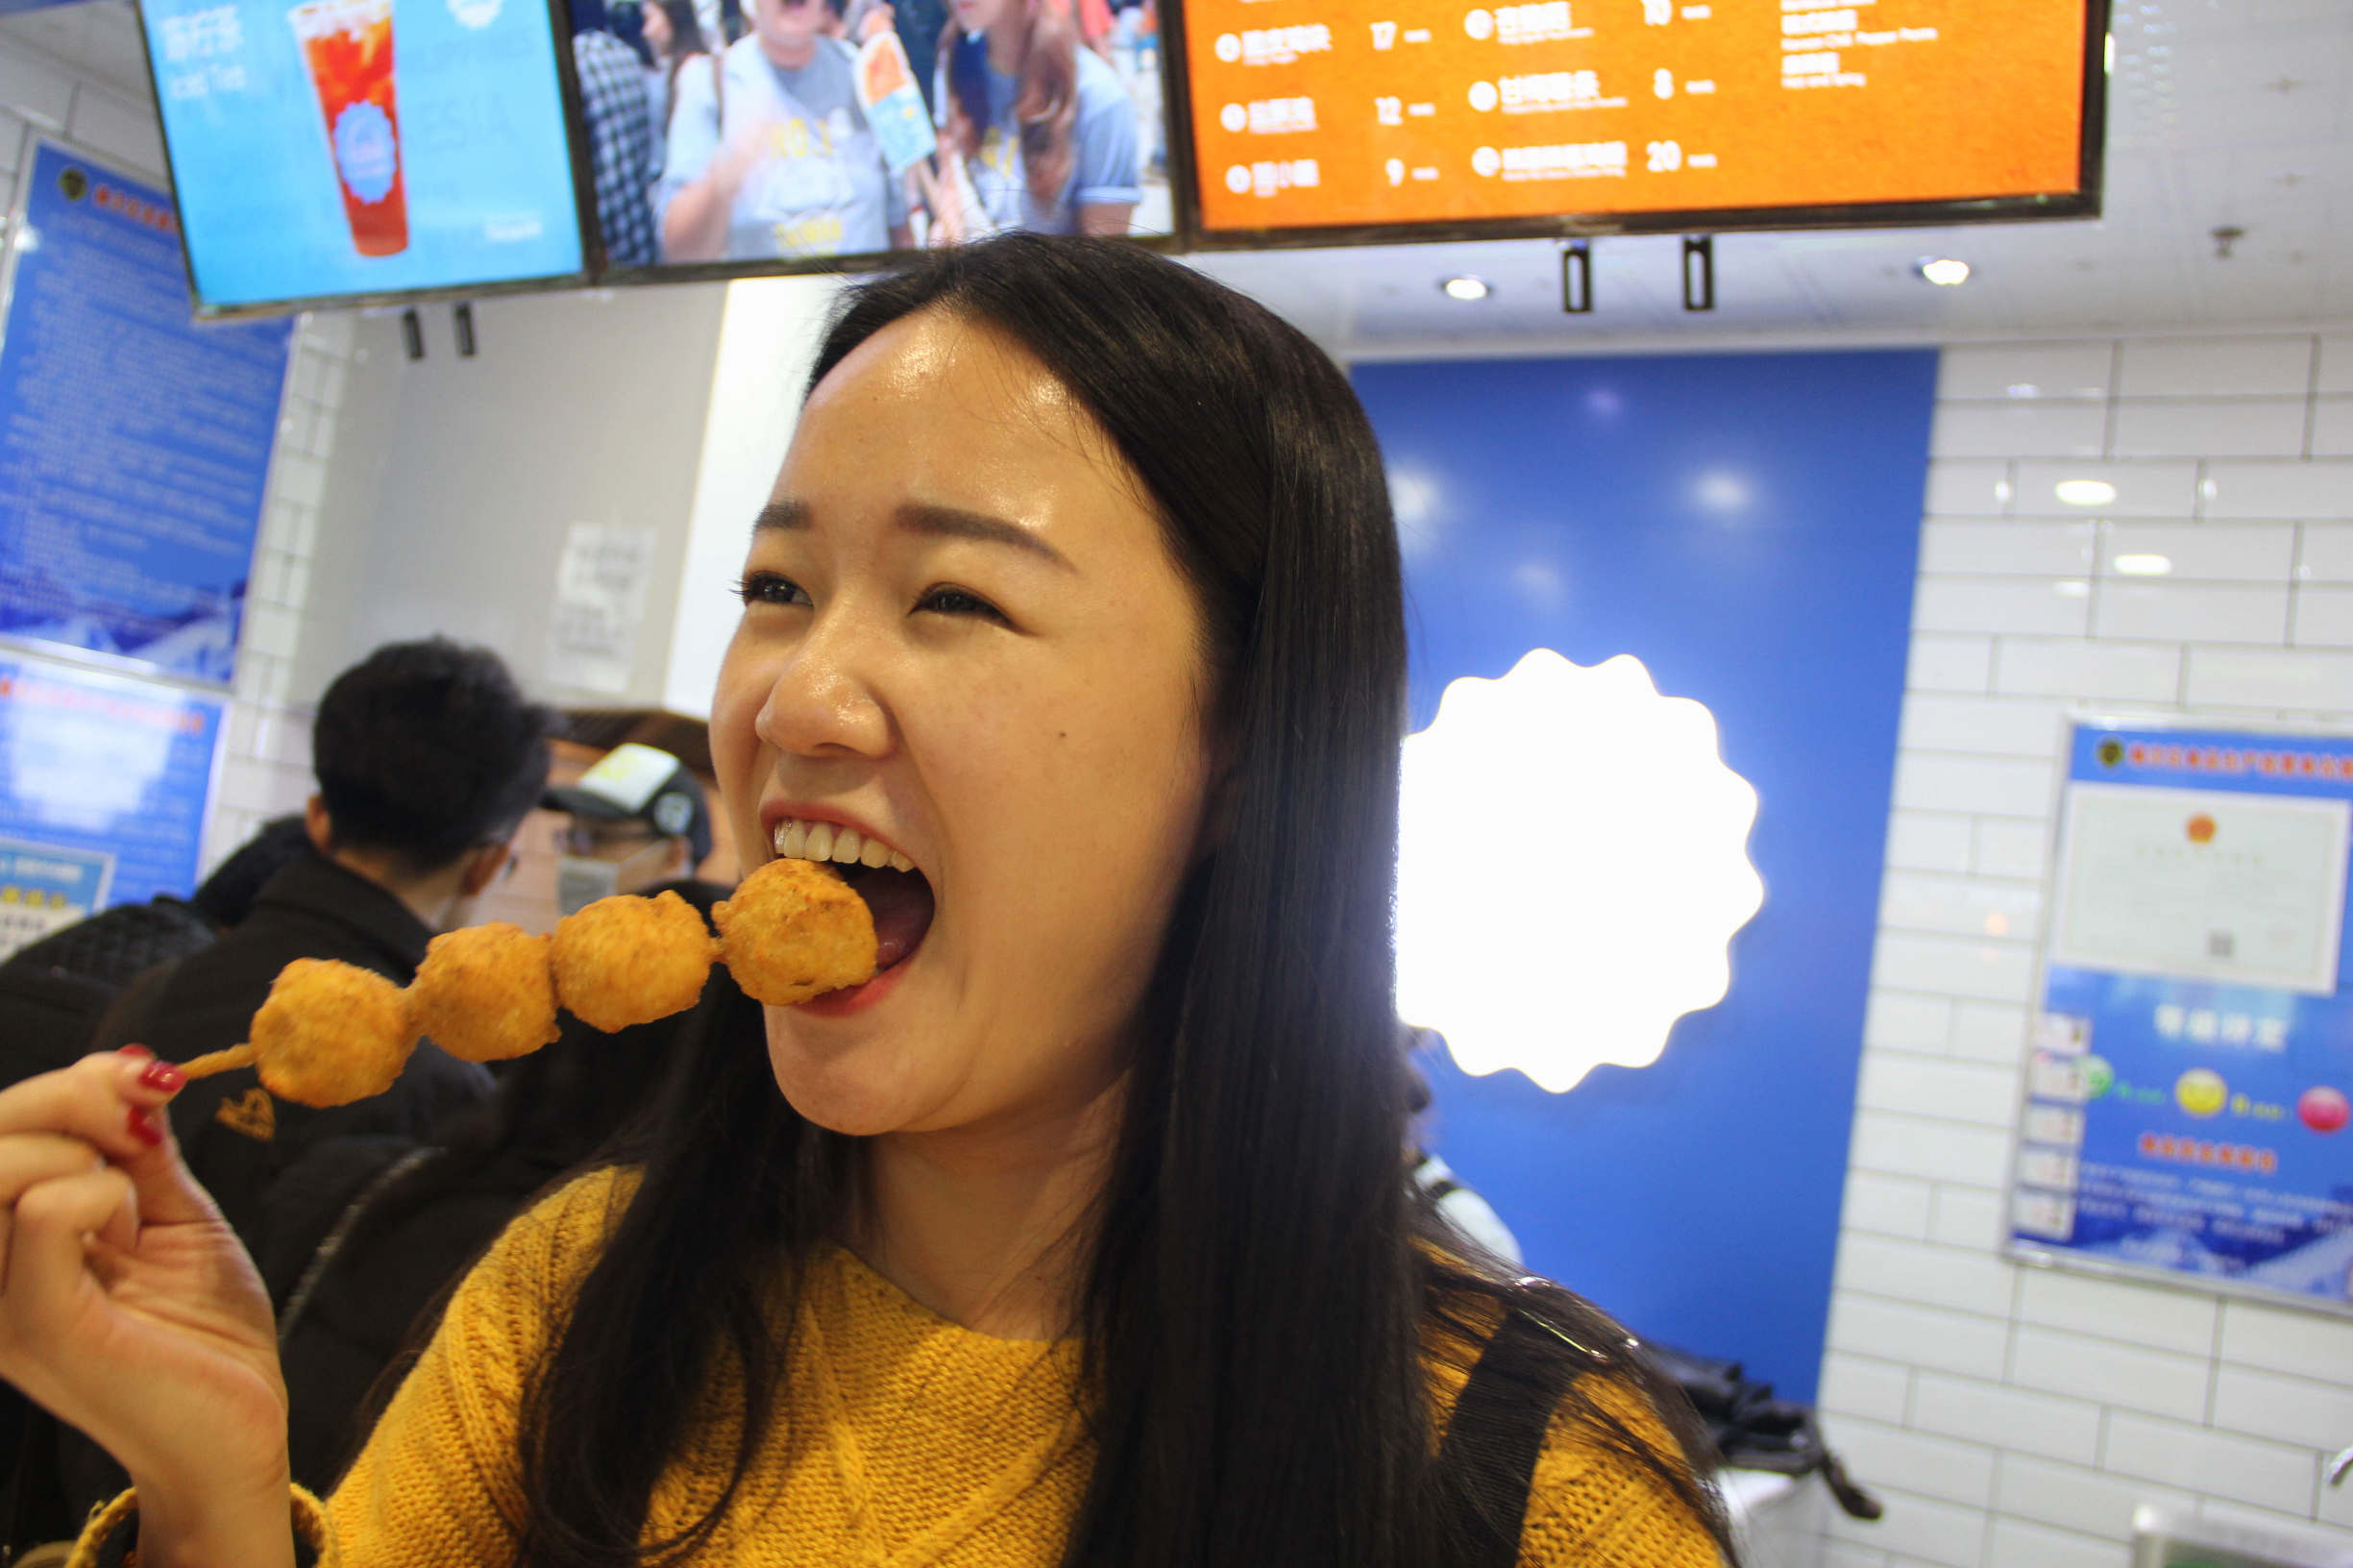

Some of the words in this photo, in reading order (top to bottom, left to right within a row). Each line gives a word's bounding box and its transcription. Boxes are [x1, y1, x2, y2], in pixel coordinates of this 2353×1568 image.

[1369, 20, 1397, 51] 17
[1654, 68, 1675, 100] 8
[1374, 96, 1403, 126] 12
[1646, 139, 1682, 172] 20
[1385, 158, 1405, 186] 9
